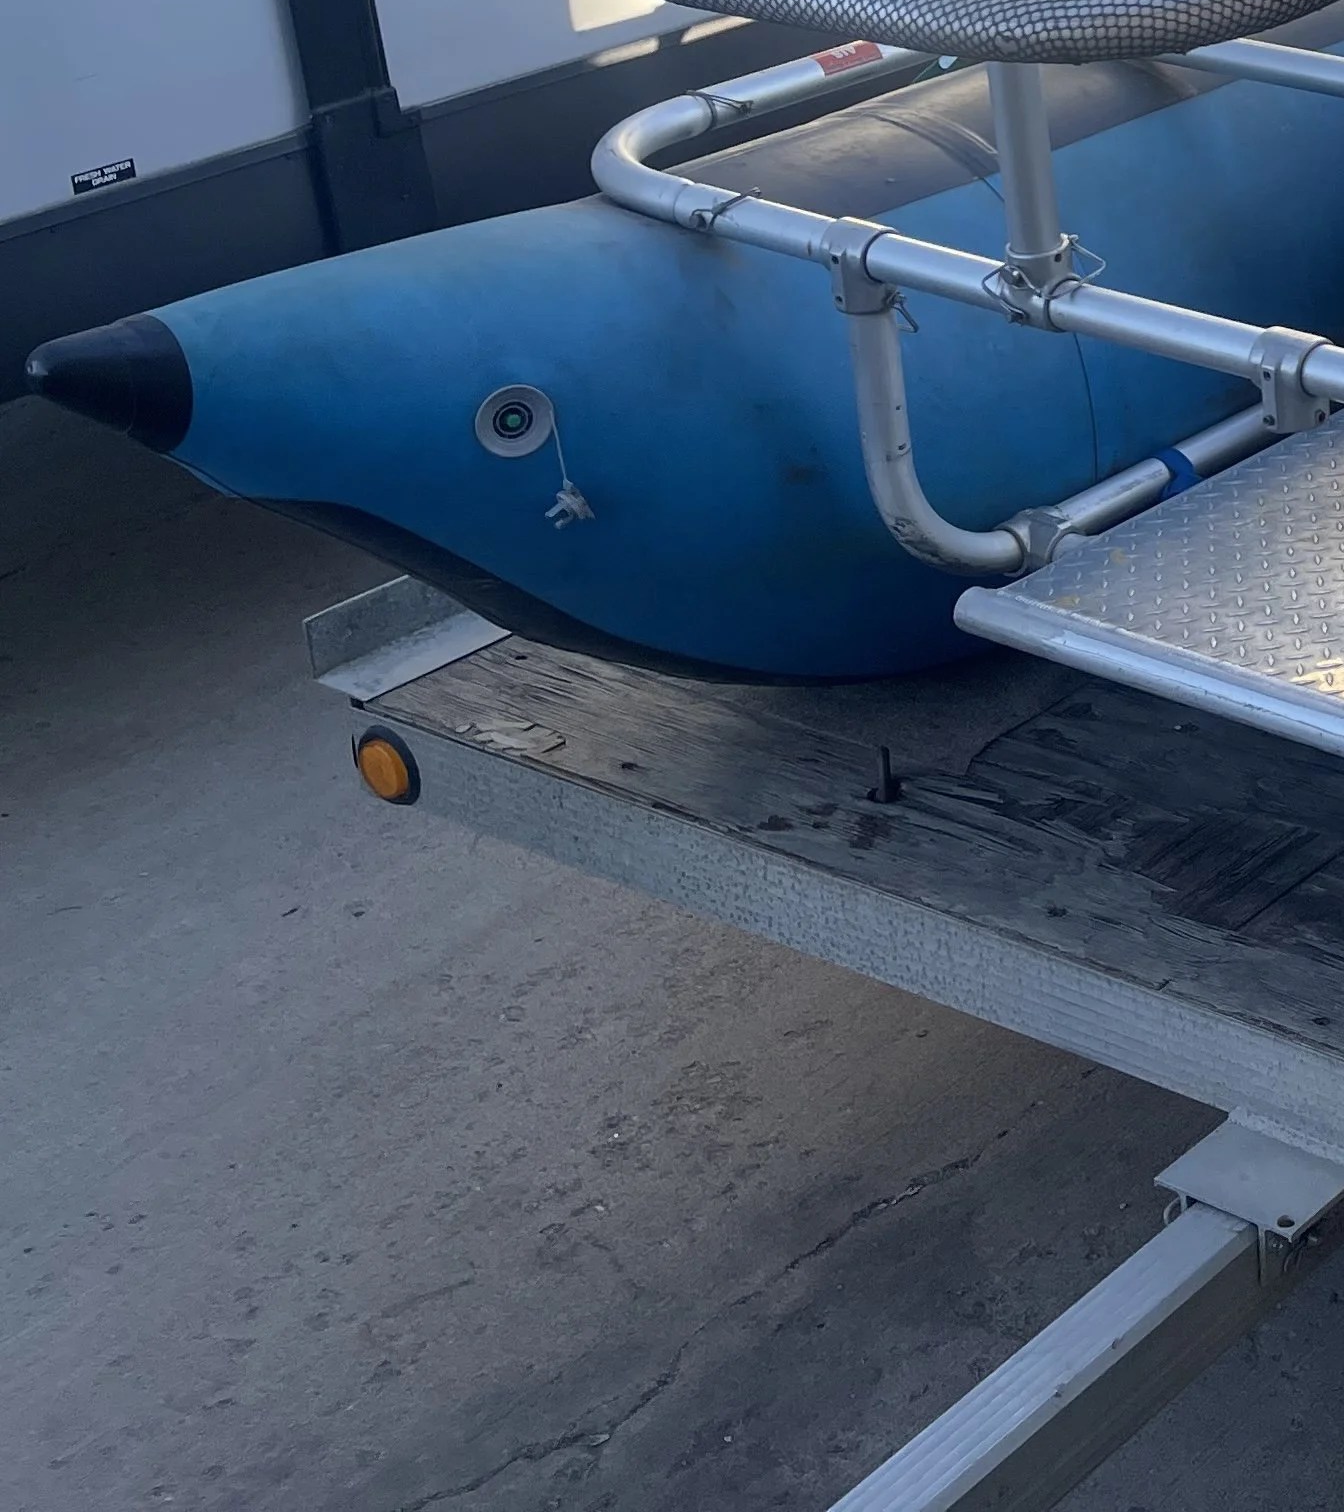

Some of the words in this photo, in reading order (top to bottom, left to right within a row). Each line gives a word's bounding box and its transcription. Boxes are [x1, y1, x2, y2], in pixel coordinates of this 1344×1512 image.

[74, 169, 102, 184] FRESH
[103, 160, 132, 175] WATER
[92, 173, 117, 187] DRAIN
